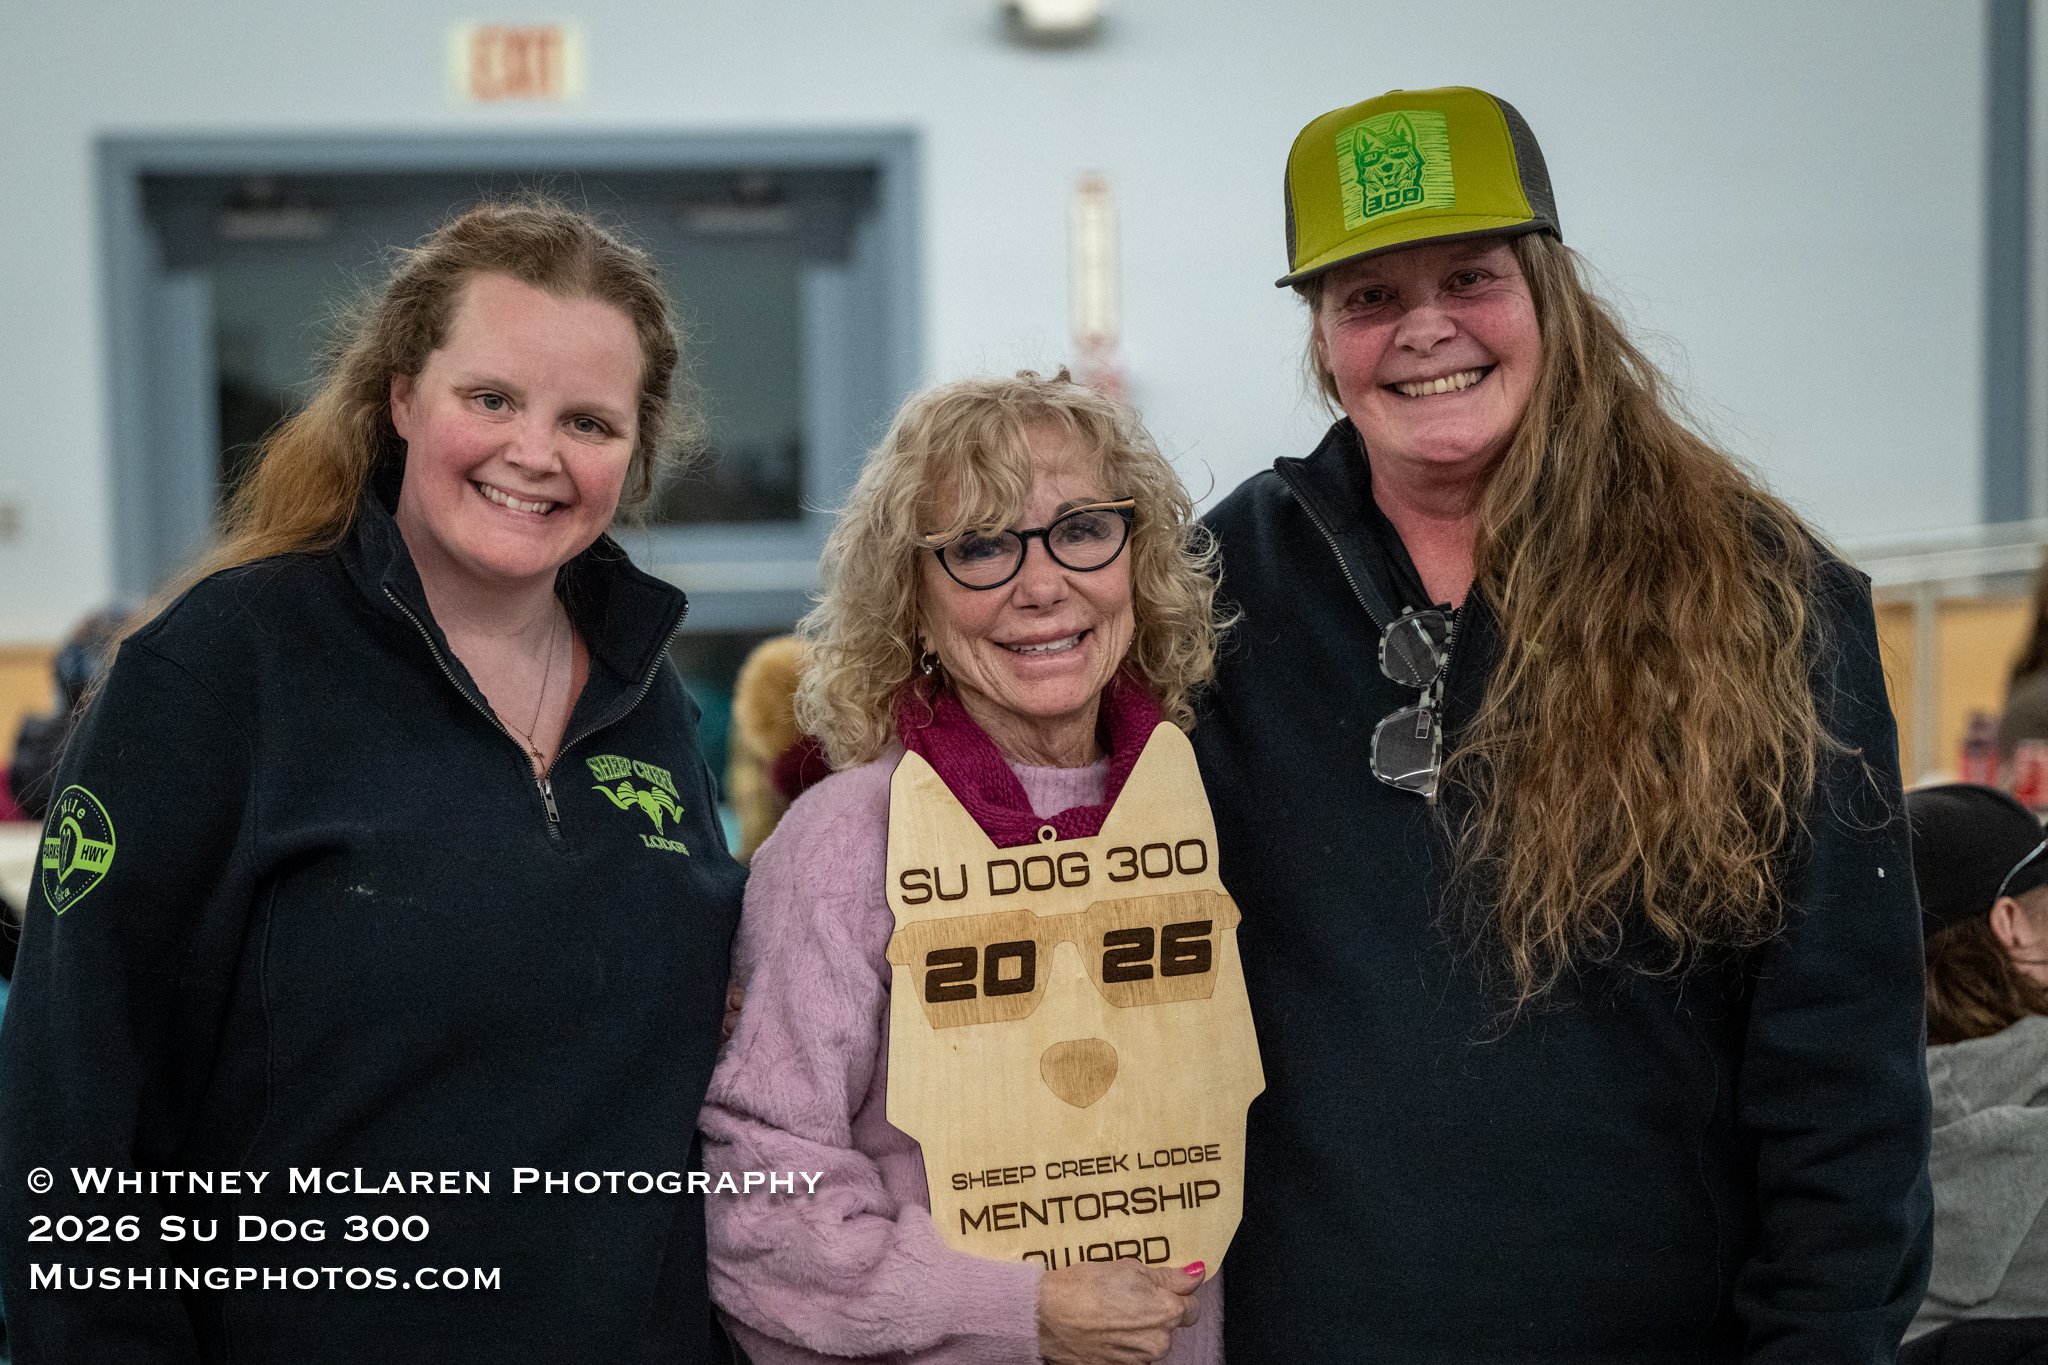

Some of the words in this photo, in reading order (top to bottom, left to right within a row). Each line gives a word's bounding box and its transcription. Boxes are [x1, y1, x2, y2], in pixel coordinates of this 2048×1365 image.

[1368, 187, 1419, 212] 300
[585, 754, 632, 782] SHEEP
[80, 844, 109, 864] HWY
[899, 864, 969, 905] SU
[986, 851, 1090, 897] DOG
[1106, 838, 1208, 883] 300
[924, 939, 1037, 1004] 20
[1102, 919, 1214, 984] 26
[951, 1165, 1037, 1191] SHEEP
[1045, 1153, 1130, 1180] CREEK
[1137, 1143, 1222, 1170] LODGE
[959, 1179, 1221, 1235] MENTORSHIP
